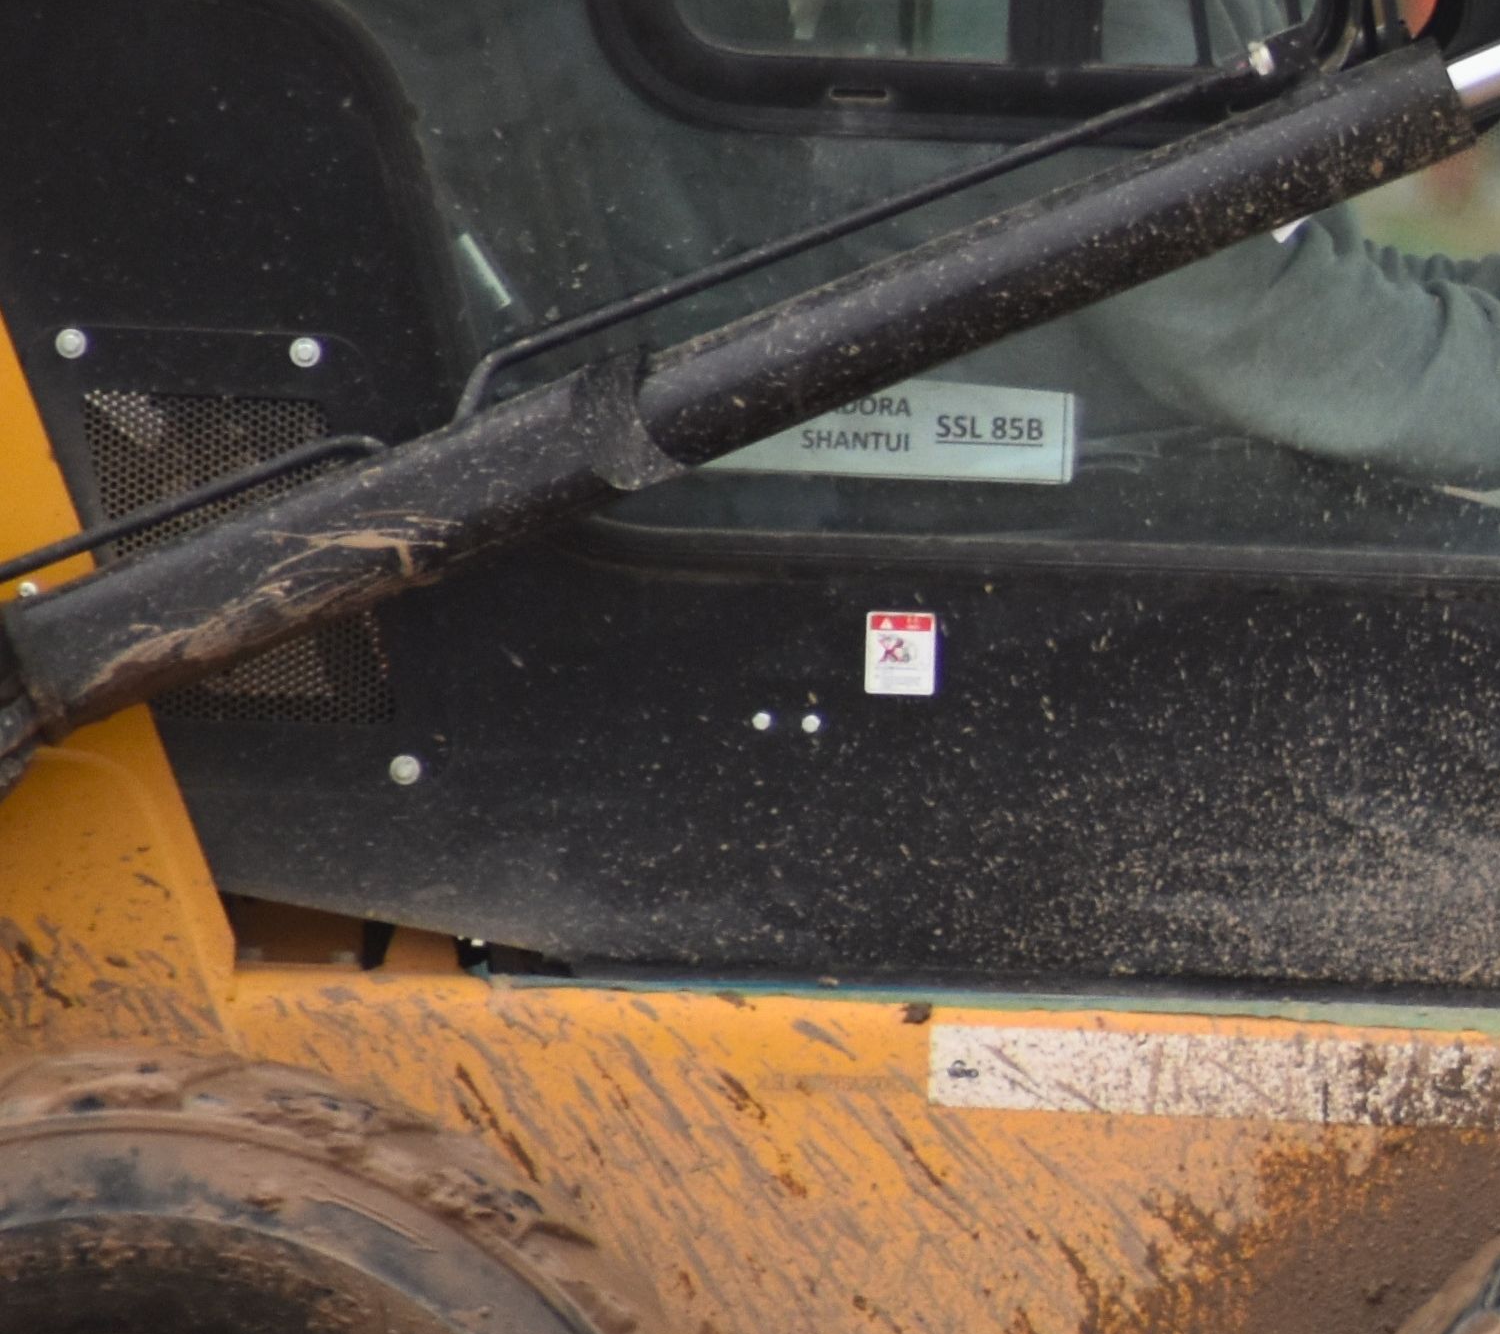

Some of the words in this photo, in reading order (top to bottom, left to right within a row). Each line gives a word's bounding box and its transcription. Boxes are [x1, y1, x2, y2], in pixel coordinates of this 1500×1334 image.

[801, 429, 910, 453] SHANTUI
[935, 414, 983, 440] SSL
[991, 416, 1044, 442] 85B
